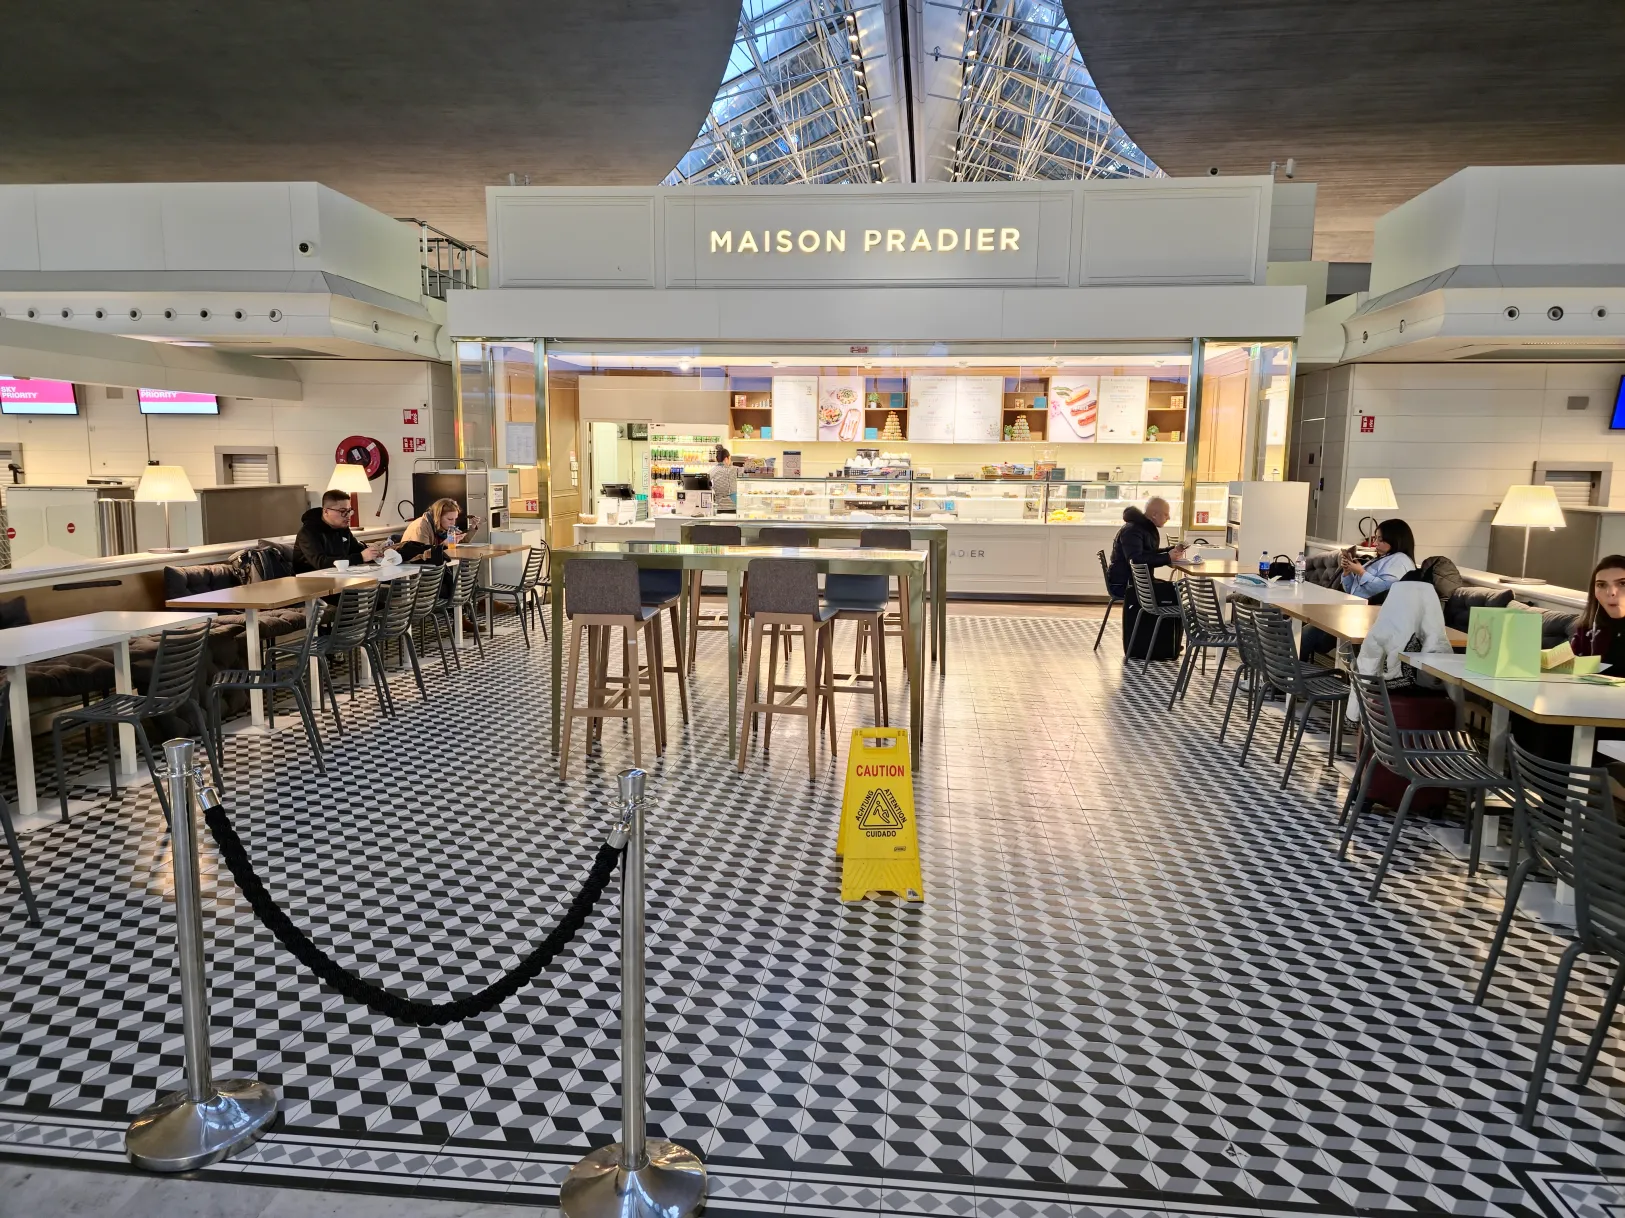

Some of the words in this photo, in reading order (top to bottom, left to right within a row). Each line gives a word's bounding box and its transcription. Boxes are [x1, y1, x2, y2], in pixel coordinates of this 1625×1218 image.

[711, 229, 847, 252] MAISON
[864, 228, 1020, 252] PRADIER
[856, 764, 905, 777] CAUTION
[855, 790, 874, 821] ACHTUNG
[884, 788, 908, 823] ATTENTION
